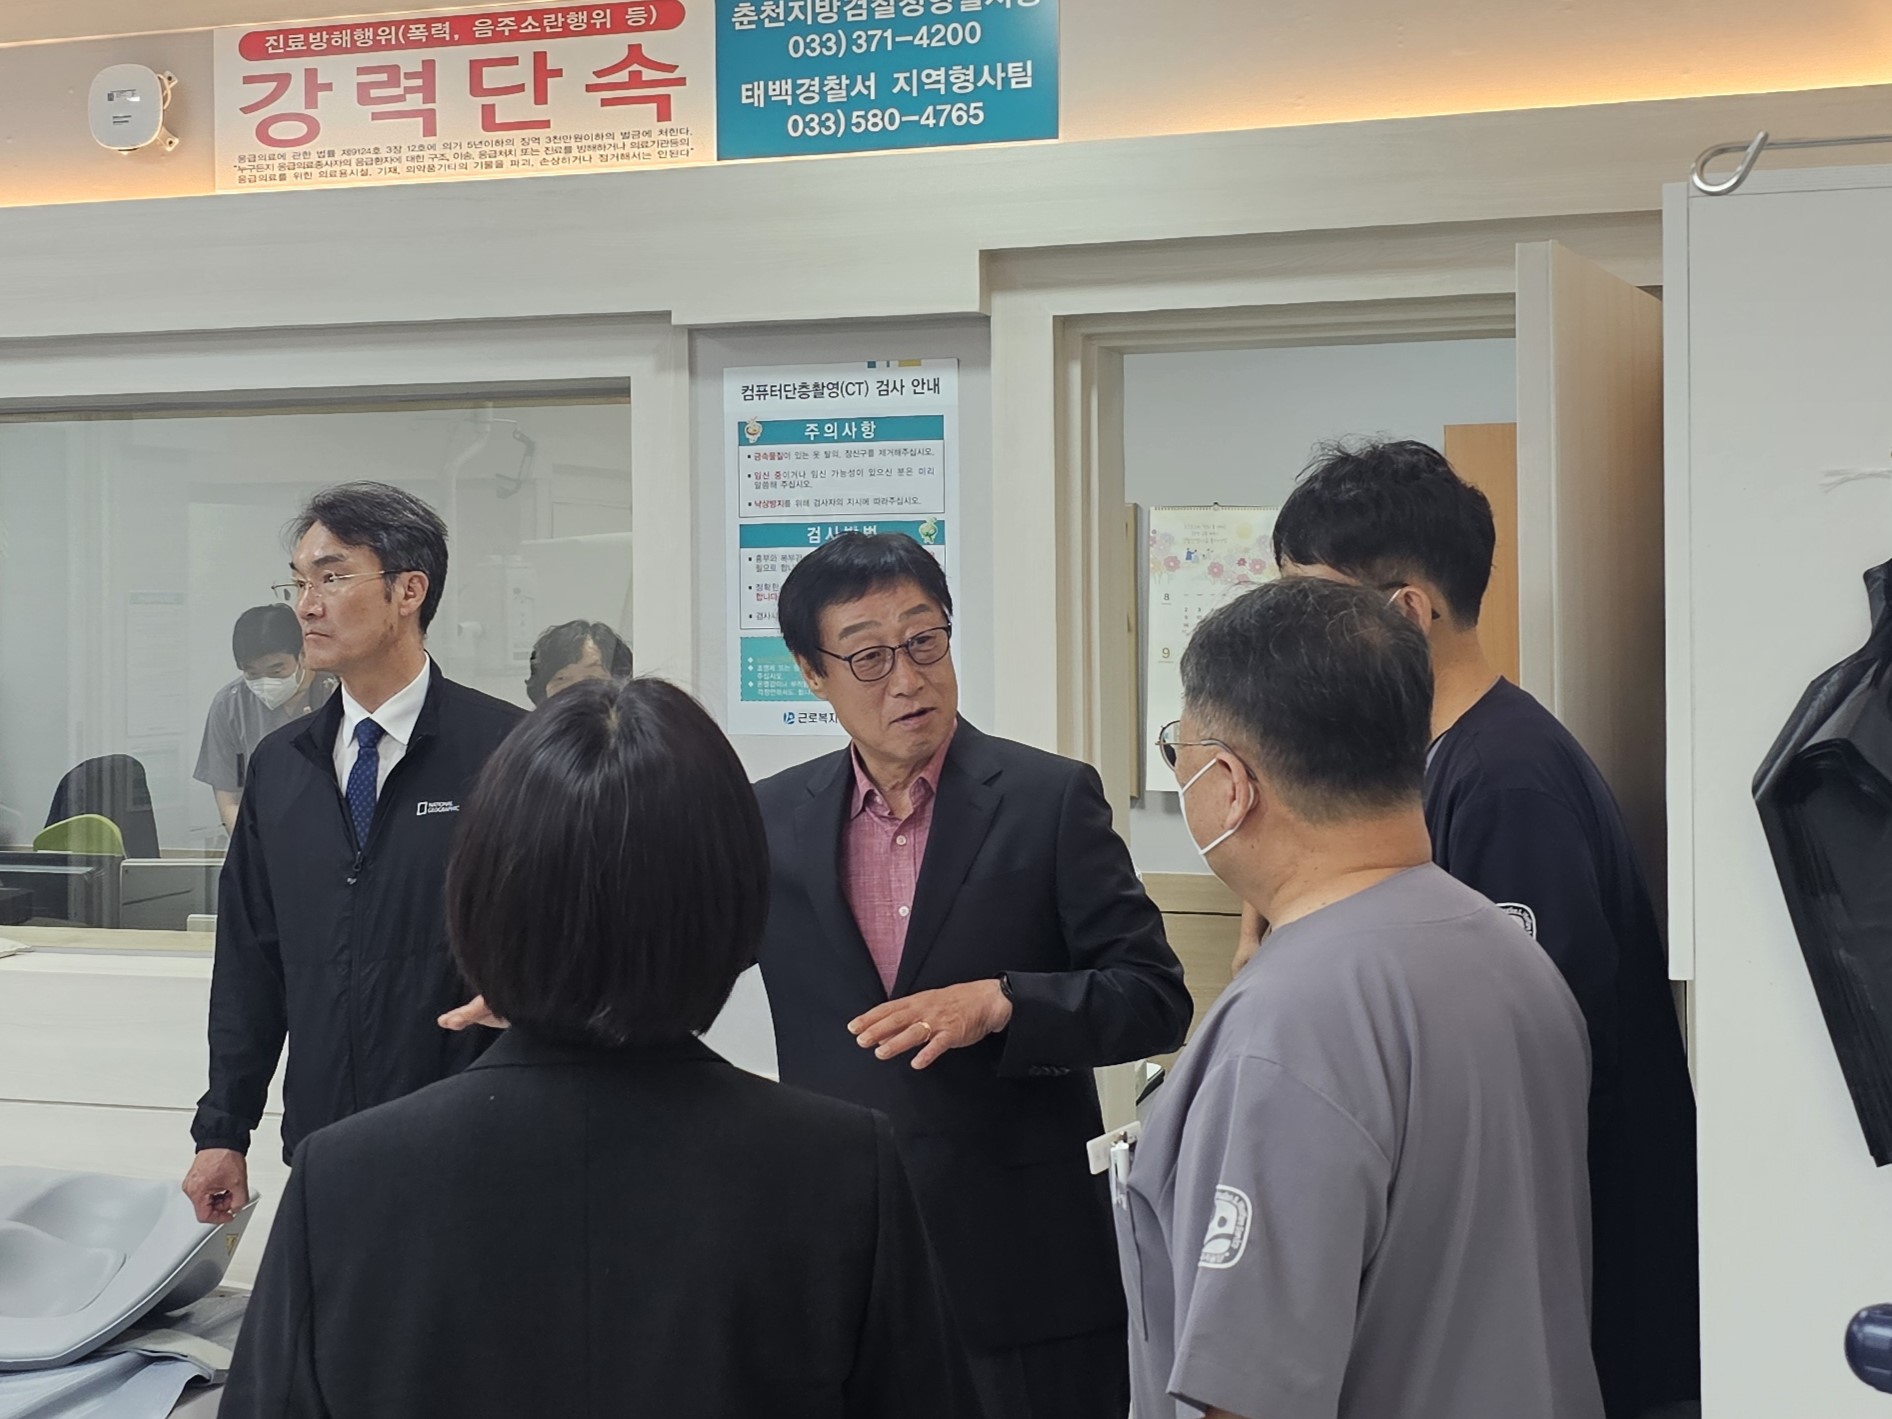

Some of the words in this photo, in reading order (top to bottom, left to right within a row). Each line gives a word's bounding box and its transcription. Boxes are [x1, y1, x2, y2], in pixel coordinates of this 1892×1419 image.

[265, 22, 459, 54] 진료방해행위(폭력,
[473, 9, 611, 38] 음주소란행위
[625, 5, 657, 27] 등)
[238, 43, 687, 149] 강력단속
[741, 73, 876, 108] 태백경찰서
[892, 60, 1033, 97] 지역형사팀
[238, 152, 287, 163] 응급의료에
[292, 150, 311, 160] 관한
[443, 142, 462, 150] 의거
[467, 138, 515, 149] 5년이하의
[520, 136, 540, 146] 징역
[545, 132, 615, 144] 3천만원이하의
[620, 129, 653, 140] 벌금에
[278, 159, 352, 171] 응급의료종사자의
[406, 154, 425, 163] 대한
[478, 148, 517, 160] 응급처치
[520, 147, 540, 156] 또는
[544, 145, 573, 156] 진료를
[577, 142, 626, 153] 방해하거나
[630, 137, 690, 149] 의료기관등의
[238, 172, 287, 184] 응급의료를
[293, 171, 313, 180] 위한
[474, 160, 504, 170] 기물을
[741, 379, 869, 401] 컴퓨터단층촬영(CT)
[876, 378, 905, 397] 검사
[911, 377, 941, 395] 안내
[804, 420, 877, 441] 주의사항
[1162, 647, 1171, 659] 9
